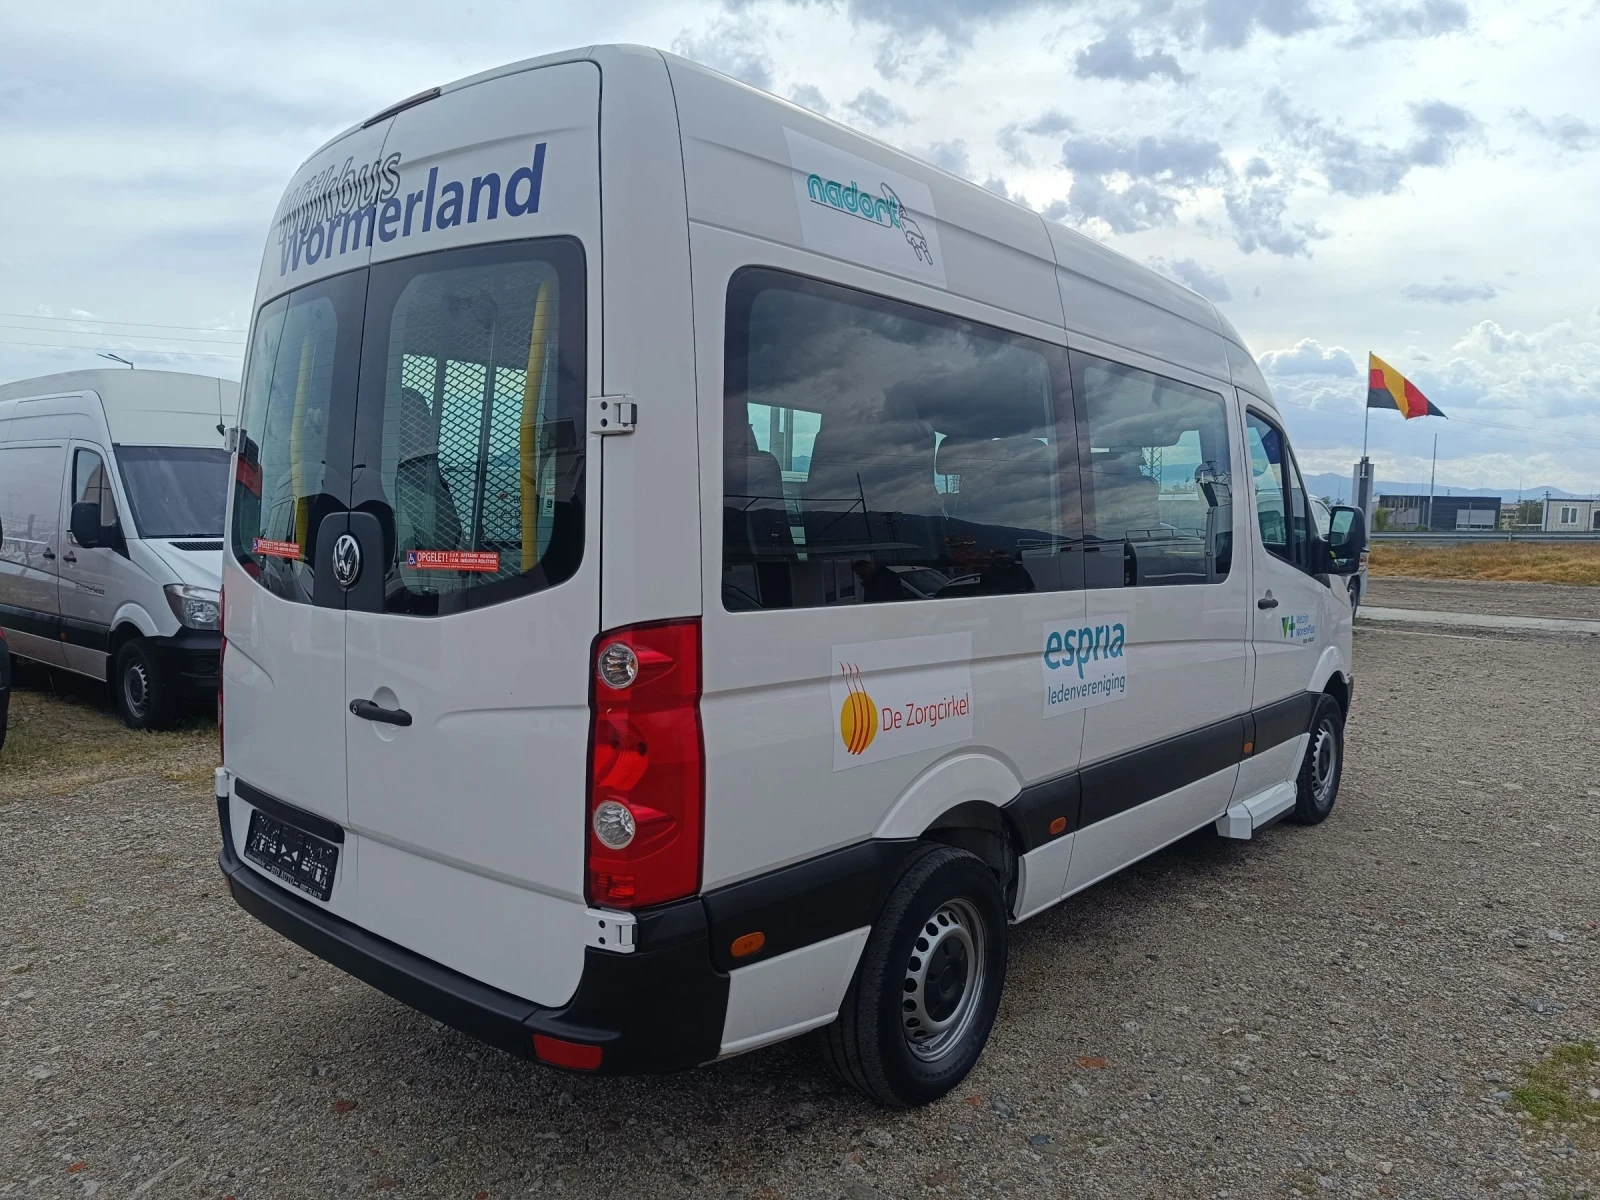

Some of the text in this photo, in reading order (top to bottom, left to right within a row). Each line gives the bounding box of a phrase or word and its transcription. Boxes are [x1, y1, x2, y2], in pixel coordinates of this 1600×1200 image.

[279, 142, 547, 277] Wormerland
[417, 552, 448, 563] OPGELET!
[1043, 623, 1125, 680] espria
[1047, 673, 1126, 705] ledenvereniging
[882, 692, 970, 731] De Zorgcirkel
[280, 870, 295, 886] AUTO
